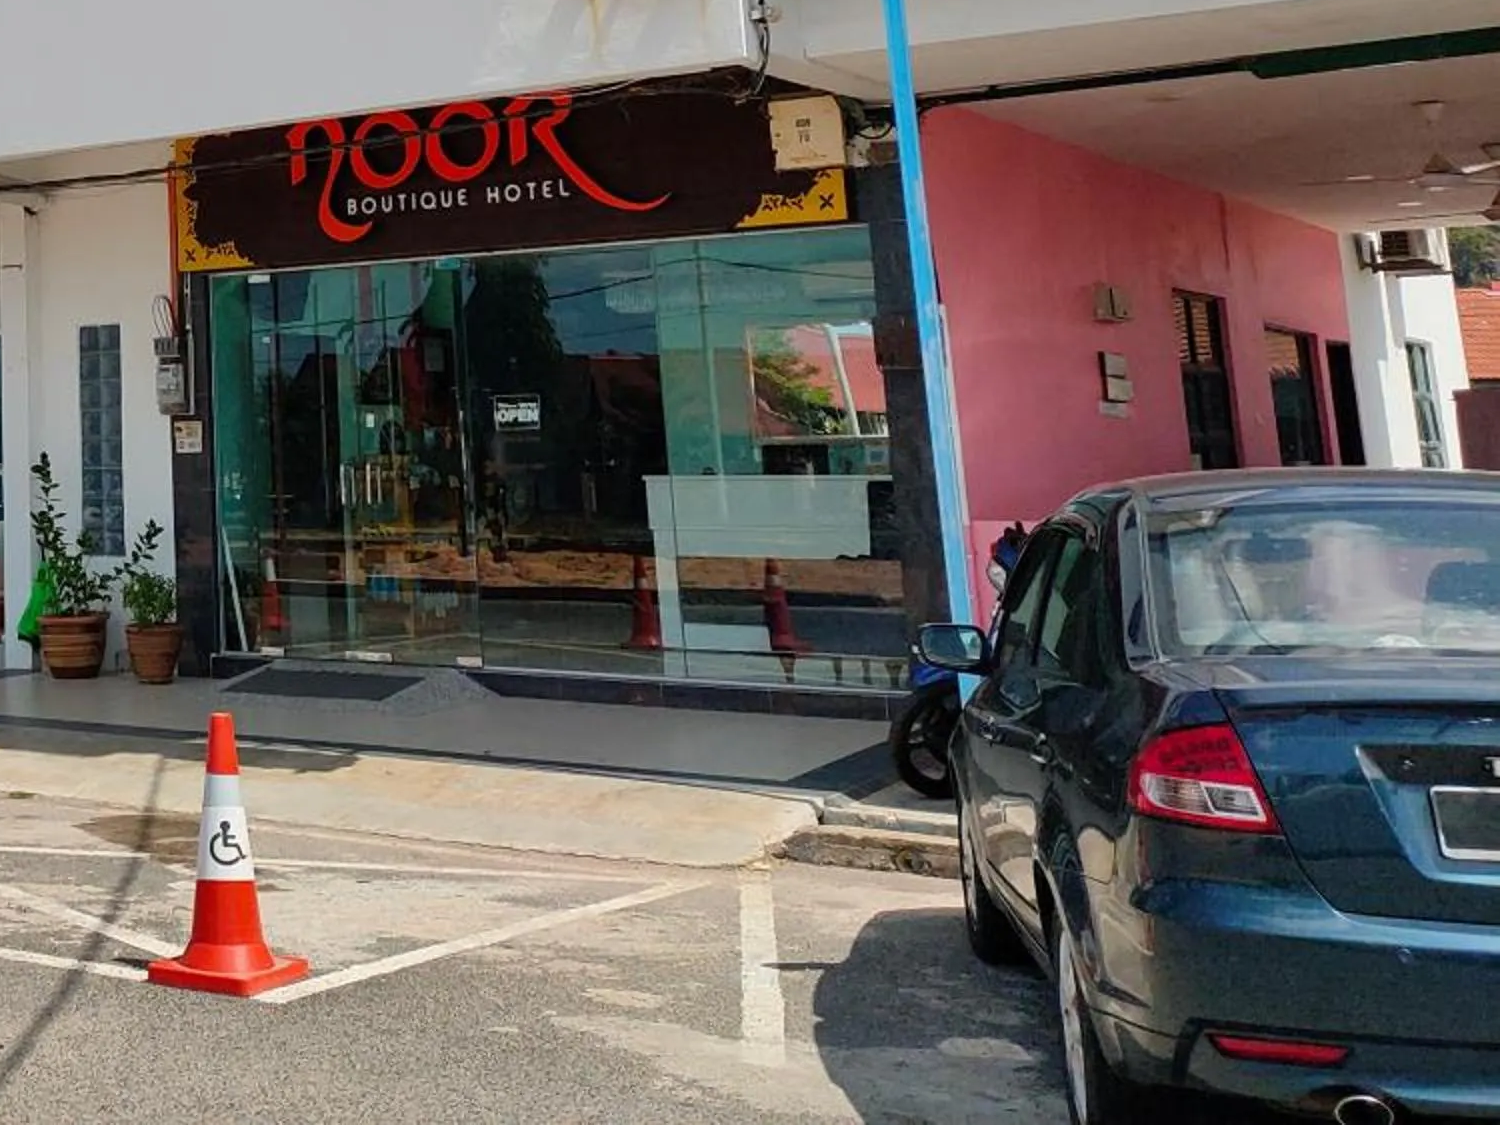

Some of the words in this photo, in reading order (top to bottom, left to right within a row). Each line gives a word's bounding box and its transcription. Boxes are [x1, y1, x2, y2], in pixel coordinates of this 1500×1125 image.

[347, 188, 468, 216] BOUTIQUE
[487, 178, 571, 204] HOTEL
[498, 409, 538, 422] OPEN
